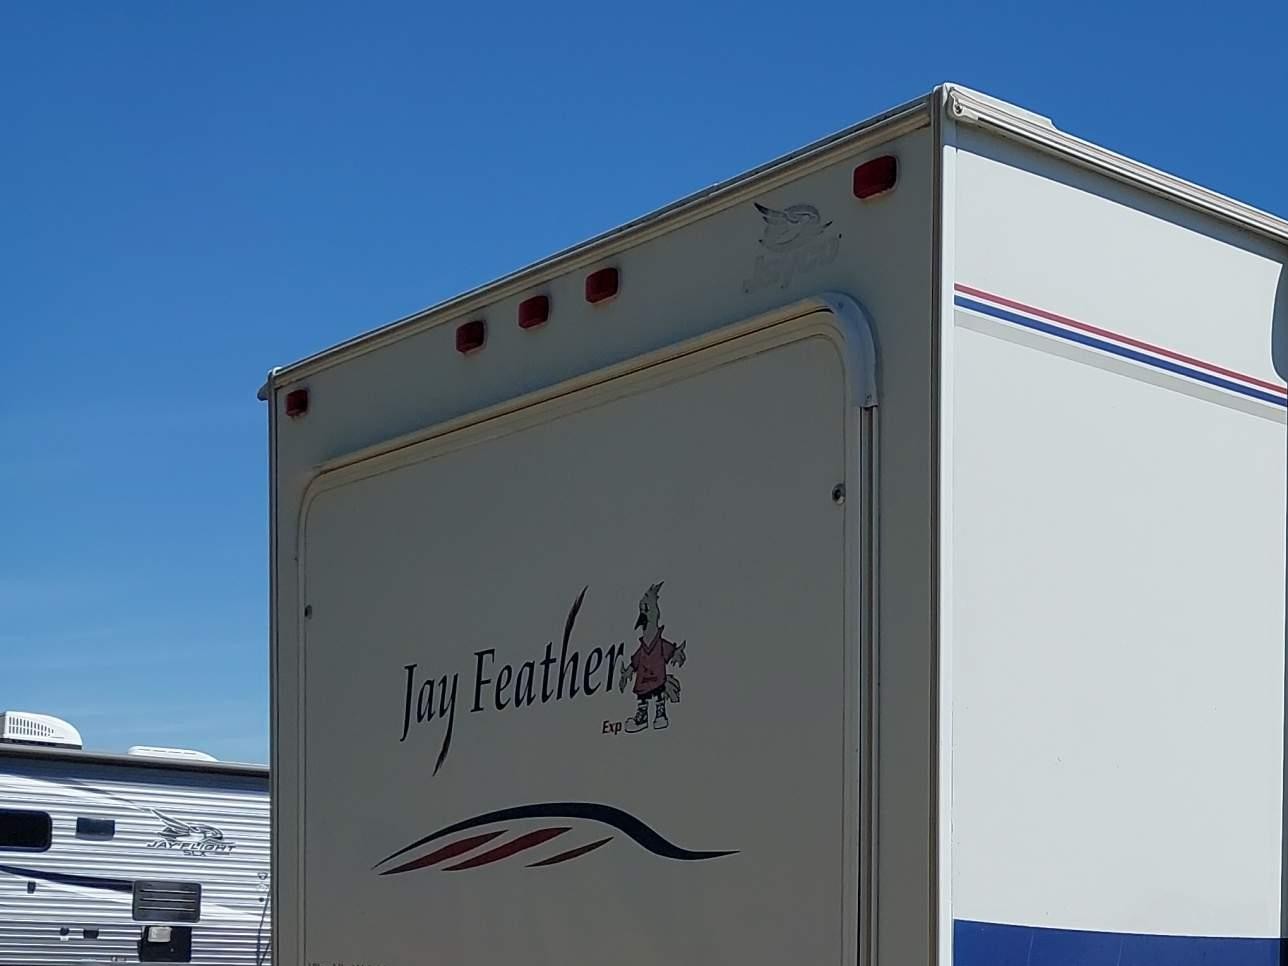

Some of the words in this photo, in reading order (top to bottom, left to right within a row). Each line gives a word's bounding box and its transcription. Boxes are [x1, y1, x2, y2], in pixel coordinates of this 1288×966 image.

[400, 662, 459, 777] Jay
[471, 584, 625, 713] Feather
[602, 719, 622, 735] Exp
[146, 841, 177, 849] JAY
[179, 841, 237, 852] FLIGHT
